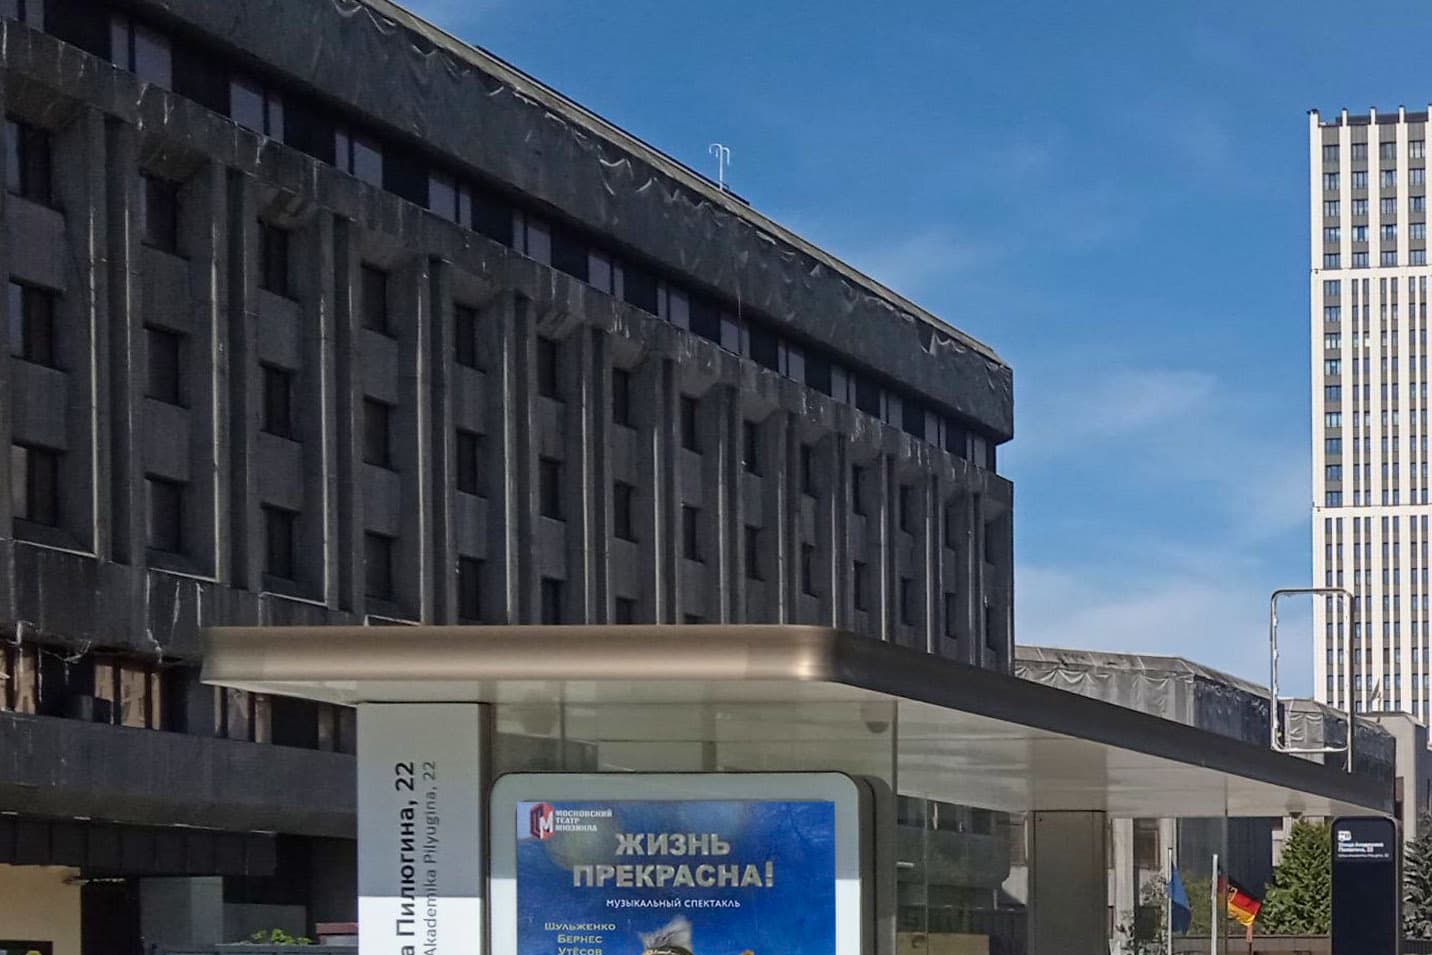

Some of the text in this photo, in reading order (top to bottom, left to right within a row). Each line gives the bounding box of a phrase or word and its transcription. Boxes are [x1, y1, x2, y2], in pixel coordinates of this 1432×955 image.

[394, 761, 415, 791] 22
[422, 760, 436, 781] 22
[423, 786, 440, 864] Pilyugina,
[614, 833, 731, 857] ЖИЗНЬ
[395, 801, 419, 936] Пилюгина,
[572, 860, 775, 888] ПРЕКРАСНА!
[606, 898, 741, 909] МУЗЫКАЛЬНЫЙ СПЕКТАКЛЬ
[557, 934, 604, 944] БЕРНЕС
